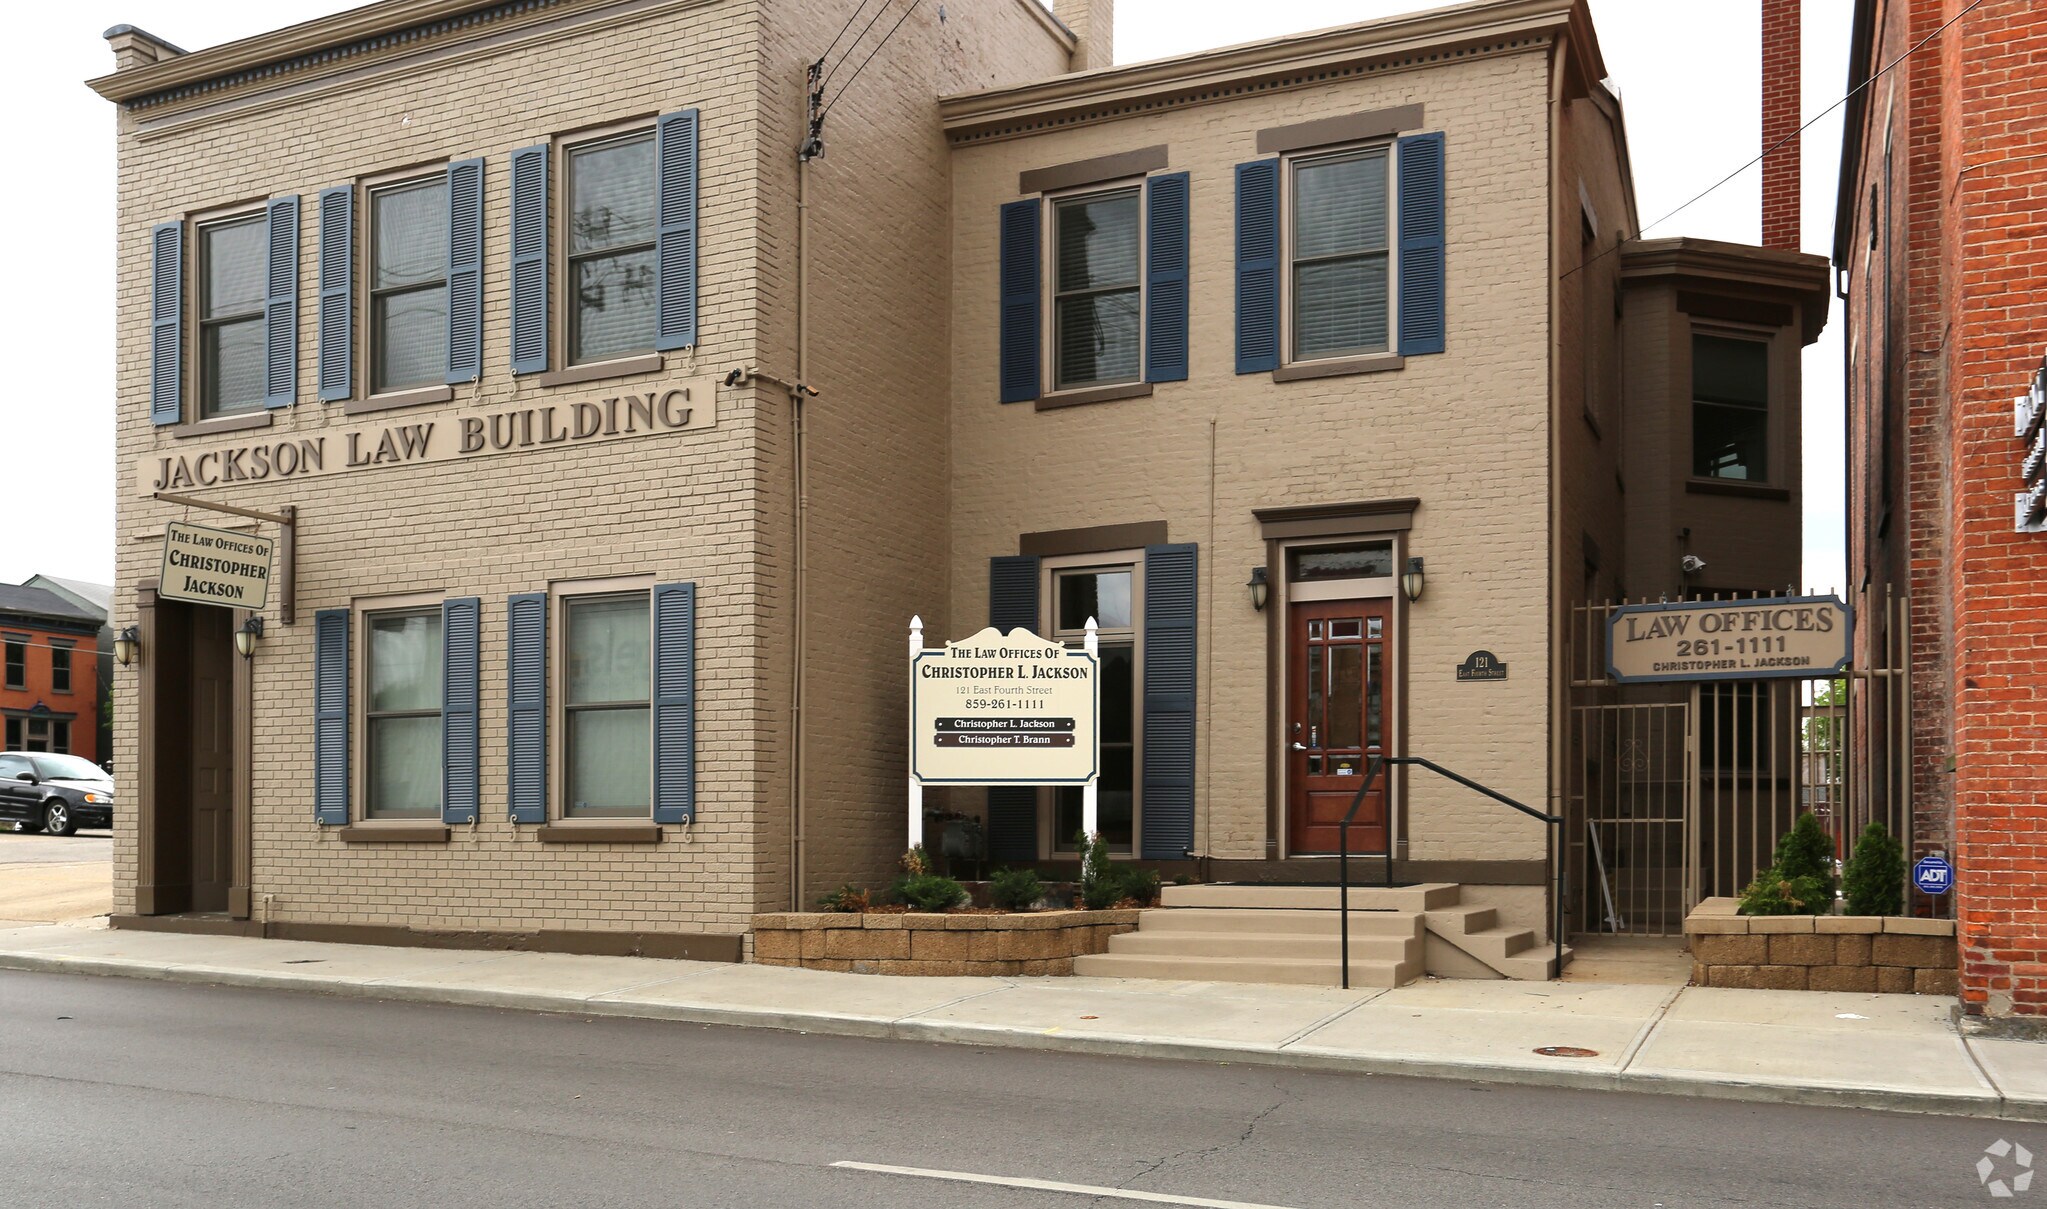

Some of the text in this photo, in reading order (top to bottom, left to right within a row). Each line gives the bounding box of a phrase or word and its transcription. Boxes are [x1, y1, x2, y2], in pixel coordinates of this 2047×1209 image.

[153, 387, 693, 490] JACKSON LAW BUILDING
[171, 530, 269, 556] THE LAW OFFICES OF
[169, 549, 267, 580] CHRISTOPHER
[183, 575, 244, 599] JACKSON
[1626, 607, 1833, 642] LAW OFFICES
[951, 647, 1060, 659] THE LAW OFFICES OF
[1677, 635, 1785, 657] 261-1111
[1475, 657, 1488, 668] 121
[1653, 656, 1810, 672] CHRISTOPHER L. JACKSON
[922, 665, 1088, 679] CHRISTOPHER L. JACKSON
[956, 686, 1053, 694] 121 East Fourth Street
[966, 699, 1044, 709] 859-261-1111
[954, 719, 1055, 730] Christopher L. Jackson
[958, 735, 1051, 745] Christopher T. Brann
[1920, 869, 1947, 882] ADT
